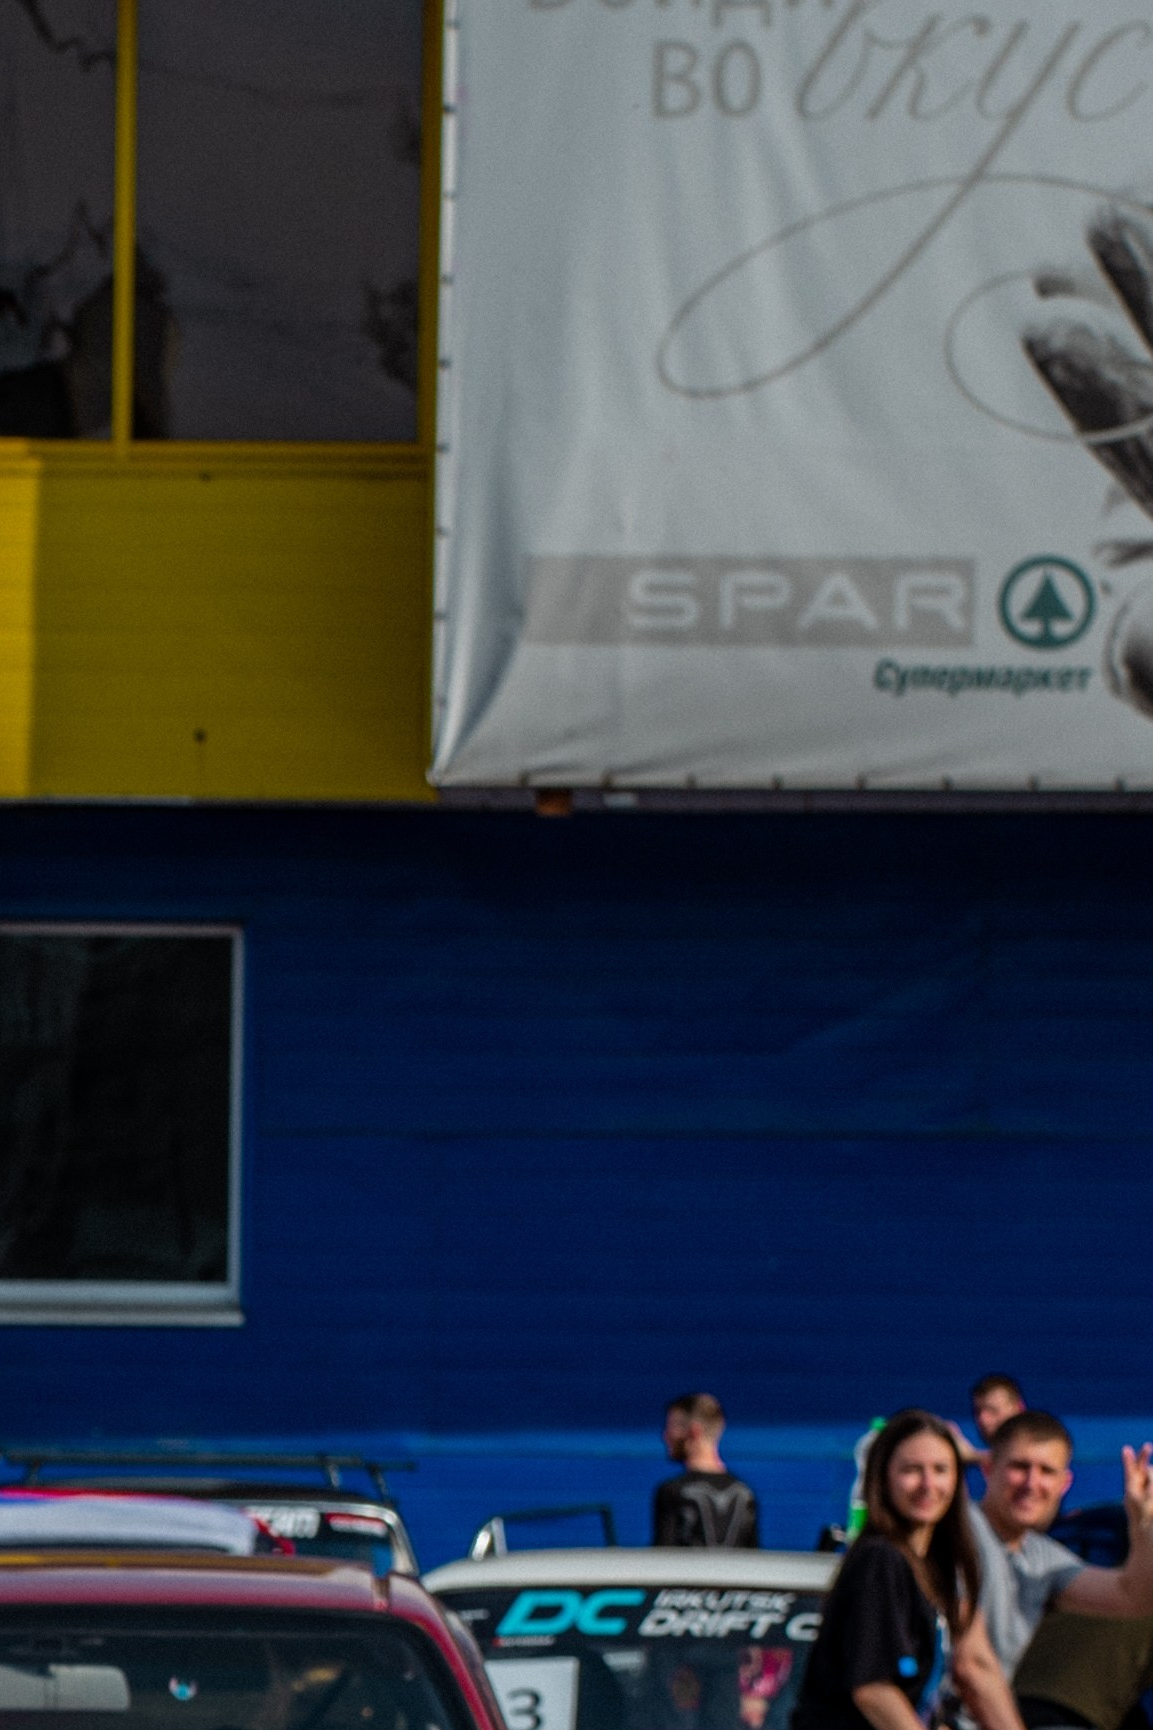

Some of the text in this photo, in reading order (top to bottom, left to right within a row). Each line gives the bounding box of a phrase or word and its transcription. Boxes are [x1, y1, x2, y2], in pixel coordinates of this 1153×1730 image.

[650, 38, 763, 119] ВО
[626, 570, 968, 630] SPAR
[873, 655, 1093, 697] Супермаркет
[494, 1588, 646, 1638] DC
[637, 1608, 787, 1640] DRIFT
